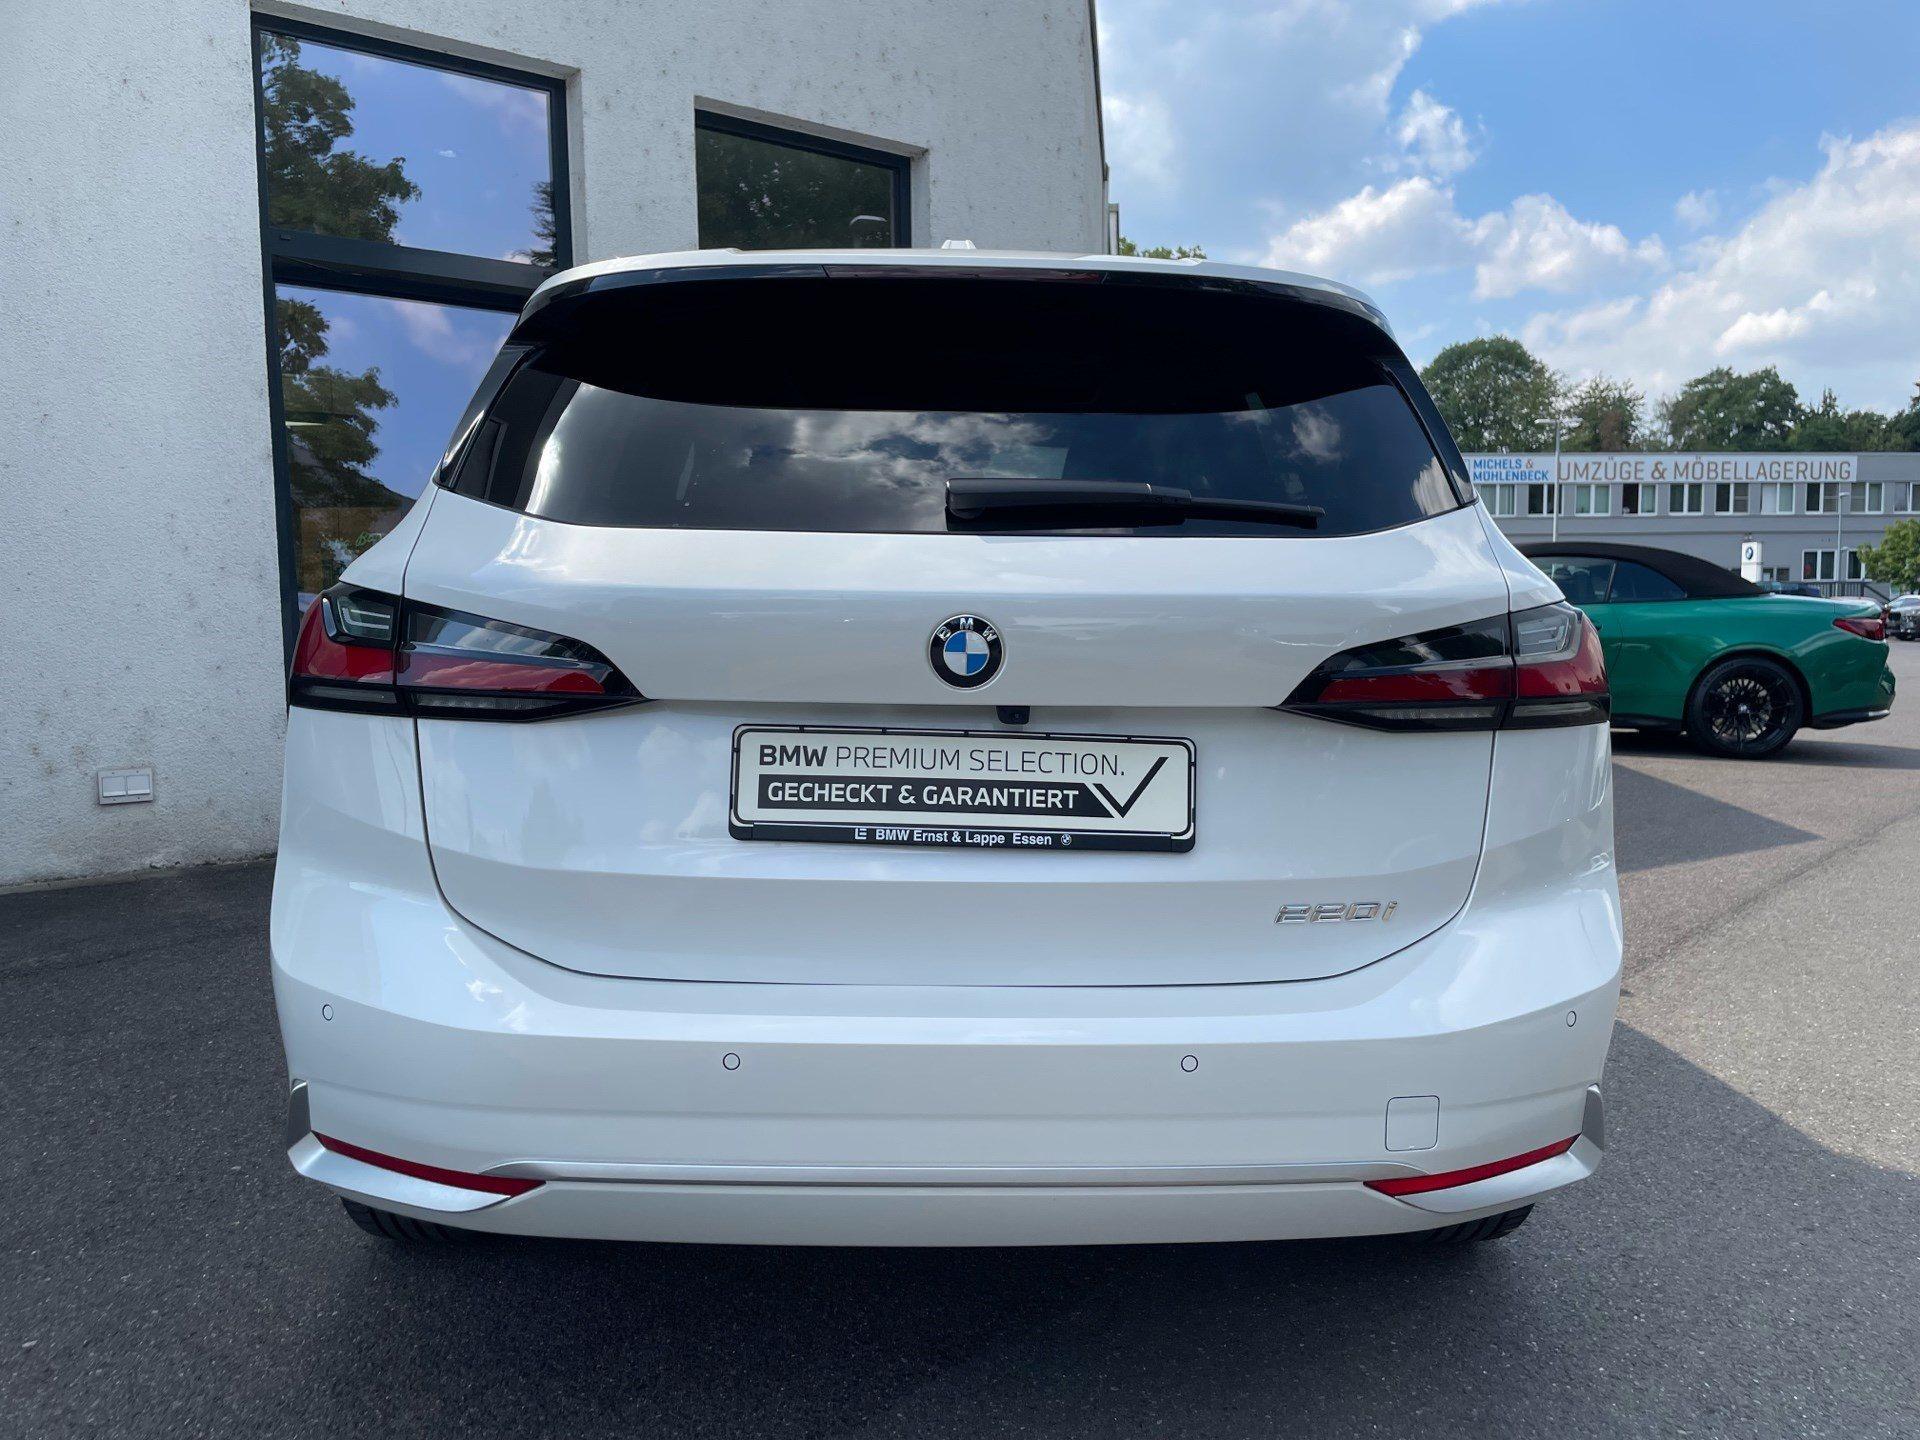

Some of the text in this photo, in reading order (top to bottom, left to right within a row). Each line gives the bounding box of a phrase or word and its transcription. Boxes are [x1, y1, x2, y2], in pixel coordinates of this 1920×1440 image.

[1473, 458, 1534, 470] MICHELS &
[1473, 470, 1550, 482] MÜHLENBECK
[1557, 455, 1851, 481] UMZÜGE & MÖBELLAGERUNG
[935, 617, 998, 642] BMW
[759, 744, 1126, 776] BMW PREMIUM SELECTION.
[767, 781, 1080, 809] GECHECKT & GARANTIERT
[875, 829, 910, 841] BMW
[913, 830, 949, 843] Ernst
[951, 831, 962, 843] &
[965, 831, 1006, 847] Lappe
[1012, 832, 1053, 846] Essen
[1274, 900, 1398, 924] 220i
